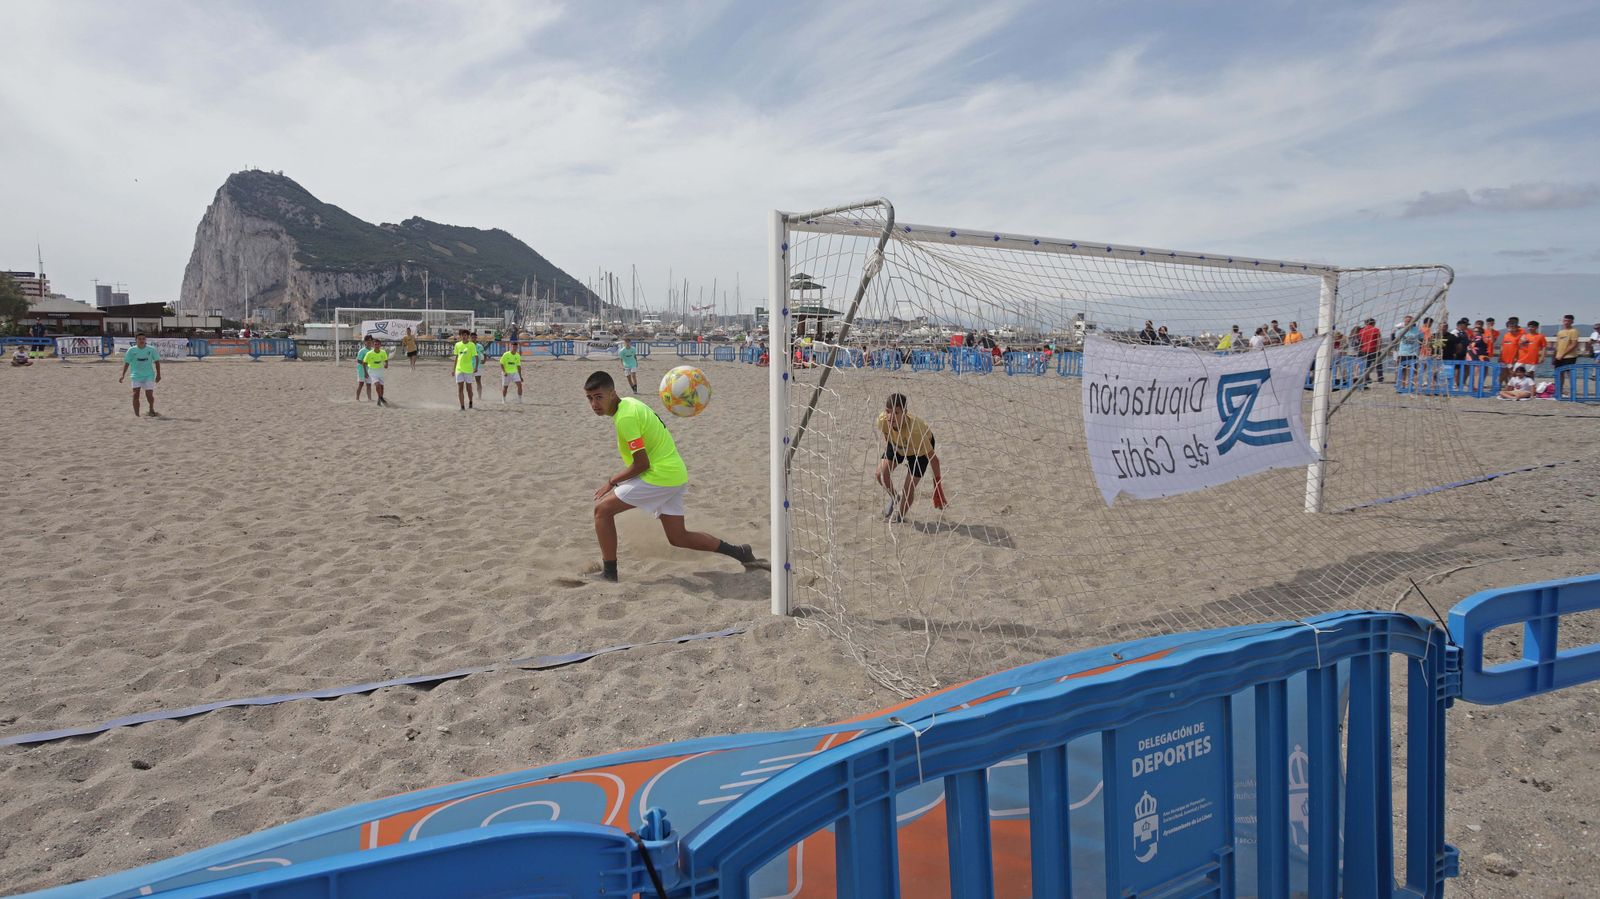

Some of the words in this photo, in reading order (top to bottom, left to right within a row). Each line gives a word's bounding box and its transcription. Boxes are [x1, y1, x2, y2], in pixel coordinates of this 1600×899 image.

[1138, 725, 1192, 751] DELEGACIÓN
[1194, 722, 1205, 734] DE
[1132, 736, 1211, 778] DEPORTES
